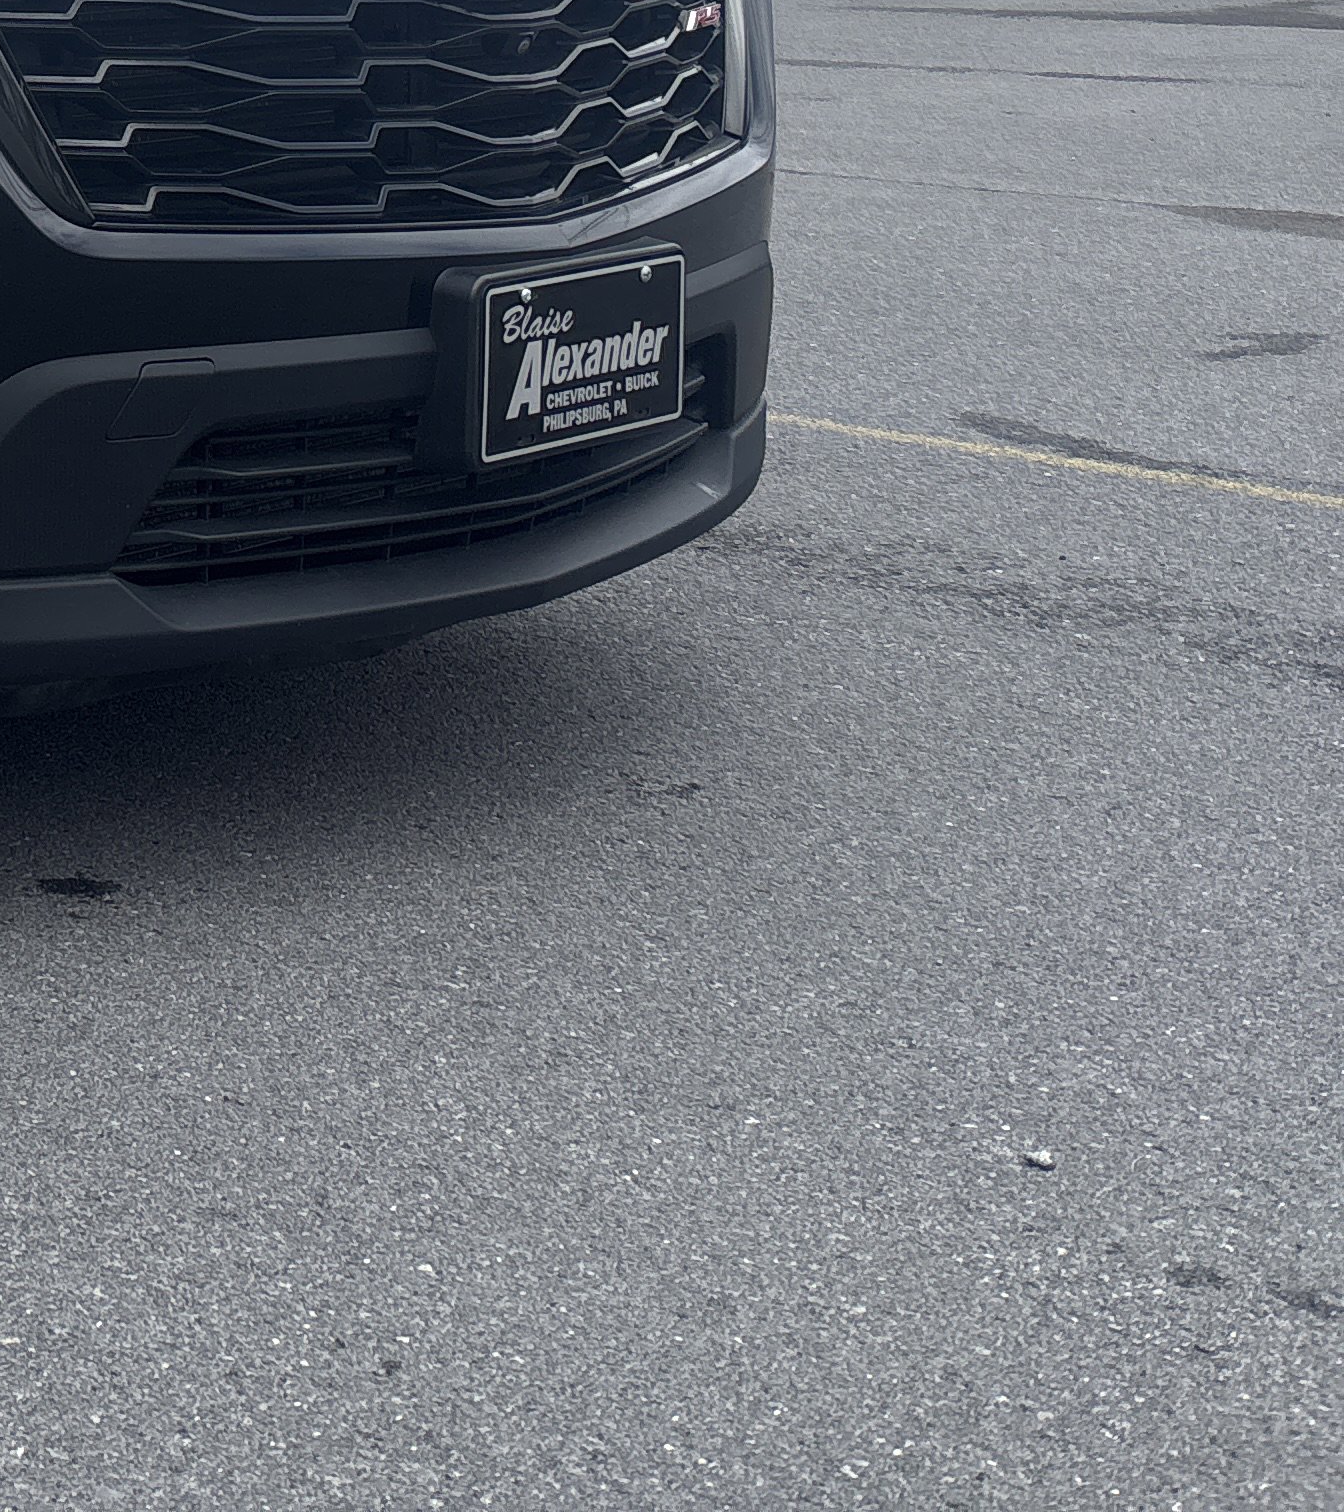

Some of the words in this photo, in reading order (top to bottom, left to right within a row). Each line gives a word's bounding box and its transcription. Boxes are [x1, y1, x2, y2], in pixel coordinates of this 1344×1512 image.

[502, 305, 574, 343] Blaise
[505, 321, 669, 420] Alexander
[546, 380, 613, 409] CHEVROLET
[625, 371, 659, 393] BUICK
[543, 402, 612, 432] PHILIPSBURG,
[613, 399, 627, 416] PA
